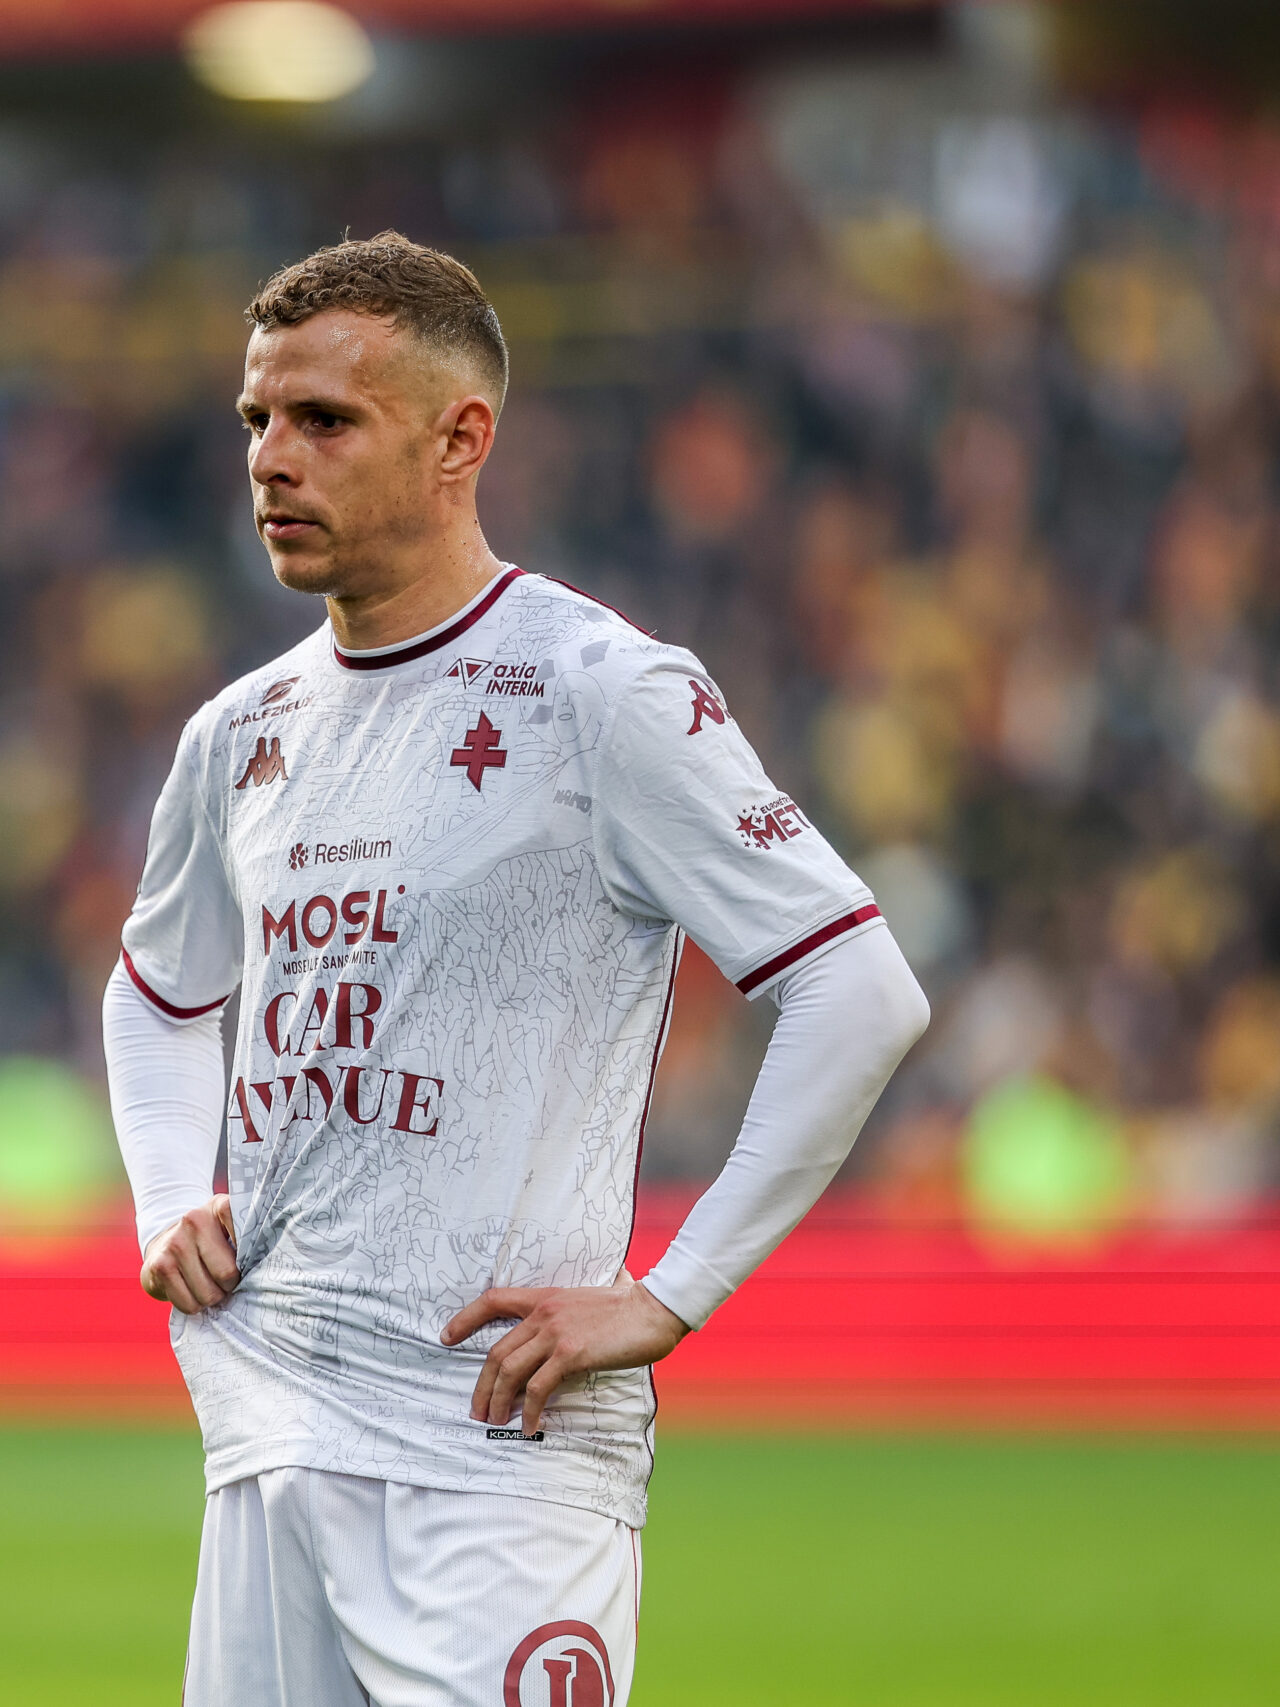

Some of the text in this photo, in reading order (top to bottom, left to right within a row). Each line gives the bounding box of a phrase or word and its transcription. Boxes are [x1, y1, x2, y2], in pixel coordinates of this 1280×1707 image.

[493, 661, 537, 679] axia
[485, 679, 545, 698] INTERIM
[314, 838, 392, 865] Resilium
[261, 889, 399, 956] MOSL
[322, 954, 349, 970] SANS
[350, 950, 377, 965] MITE
[263, 981, 383, 1057] CAR
